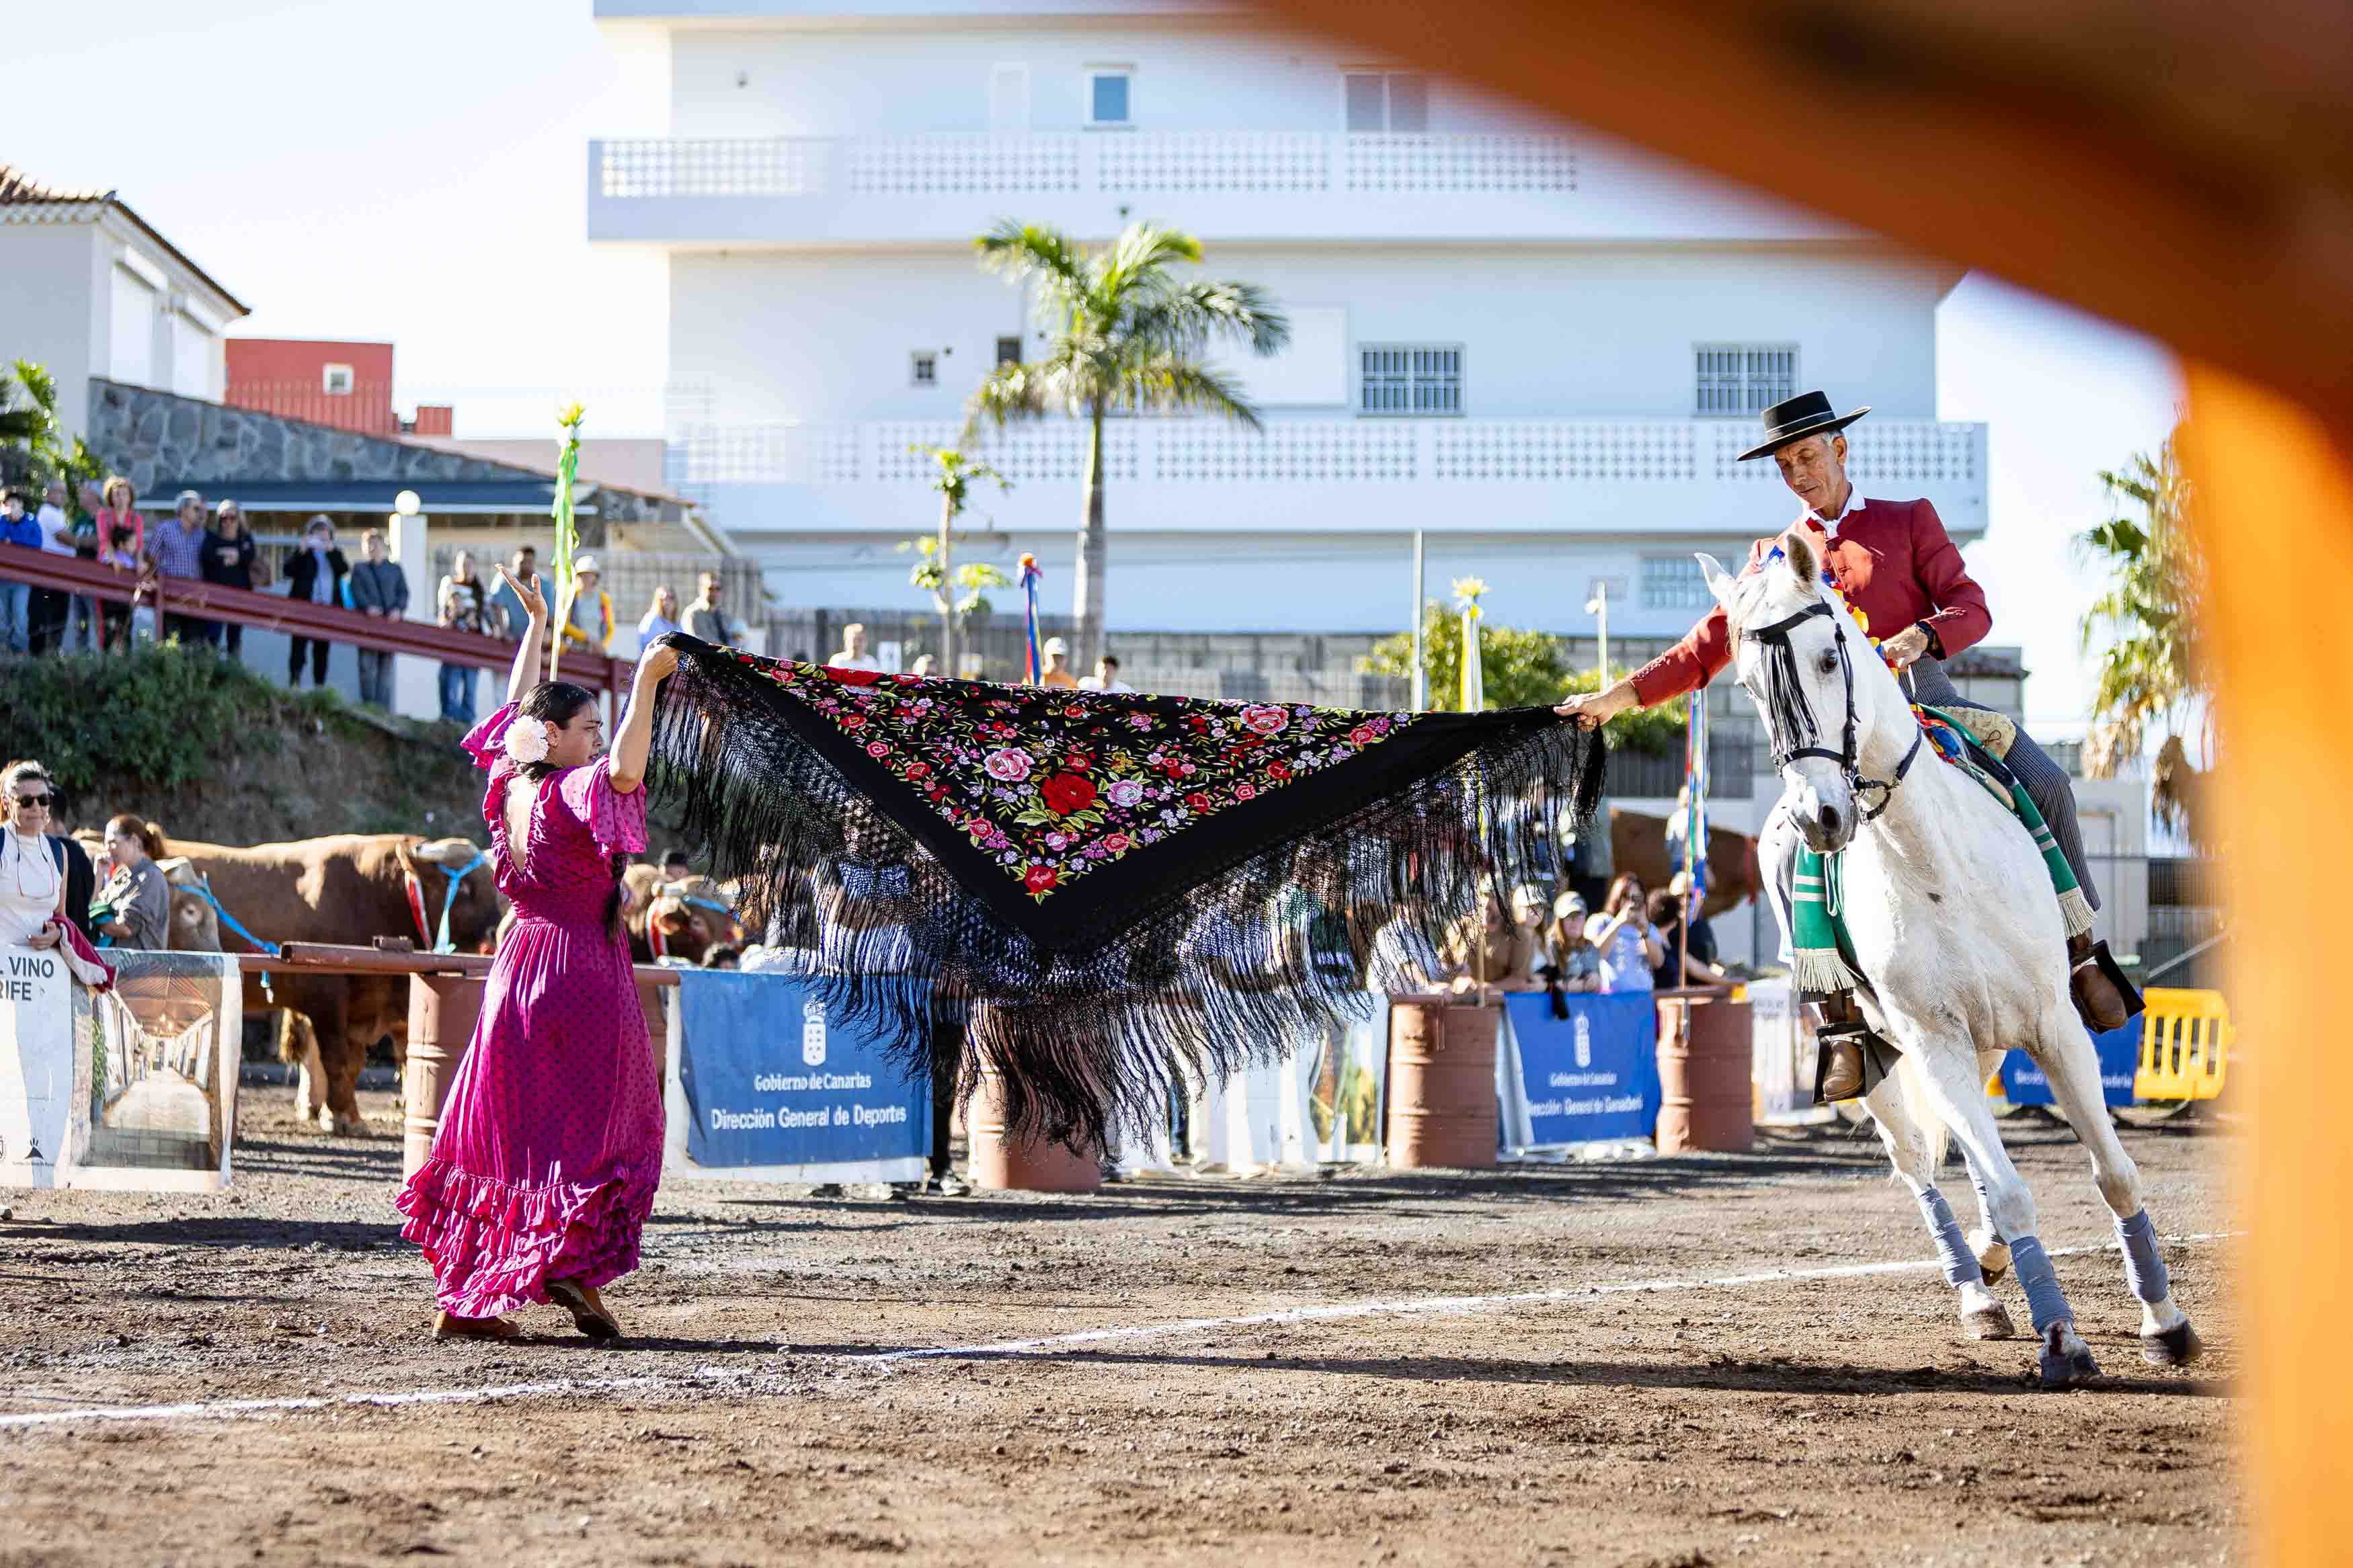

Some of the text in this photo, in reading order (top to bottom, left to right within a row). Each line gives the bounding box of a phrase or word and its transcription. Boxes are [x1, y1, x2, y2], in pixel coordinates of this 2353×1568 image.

[9, 956, 54, 978] VINO
[754, 1071, 871, 1091] Gobierno de Canarias
[711, 1104, 907, 1130] Dirección General de Deportes
